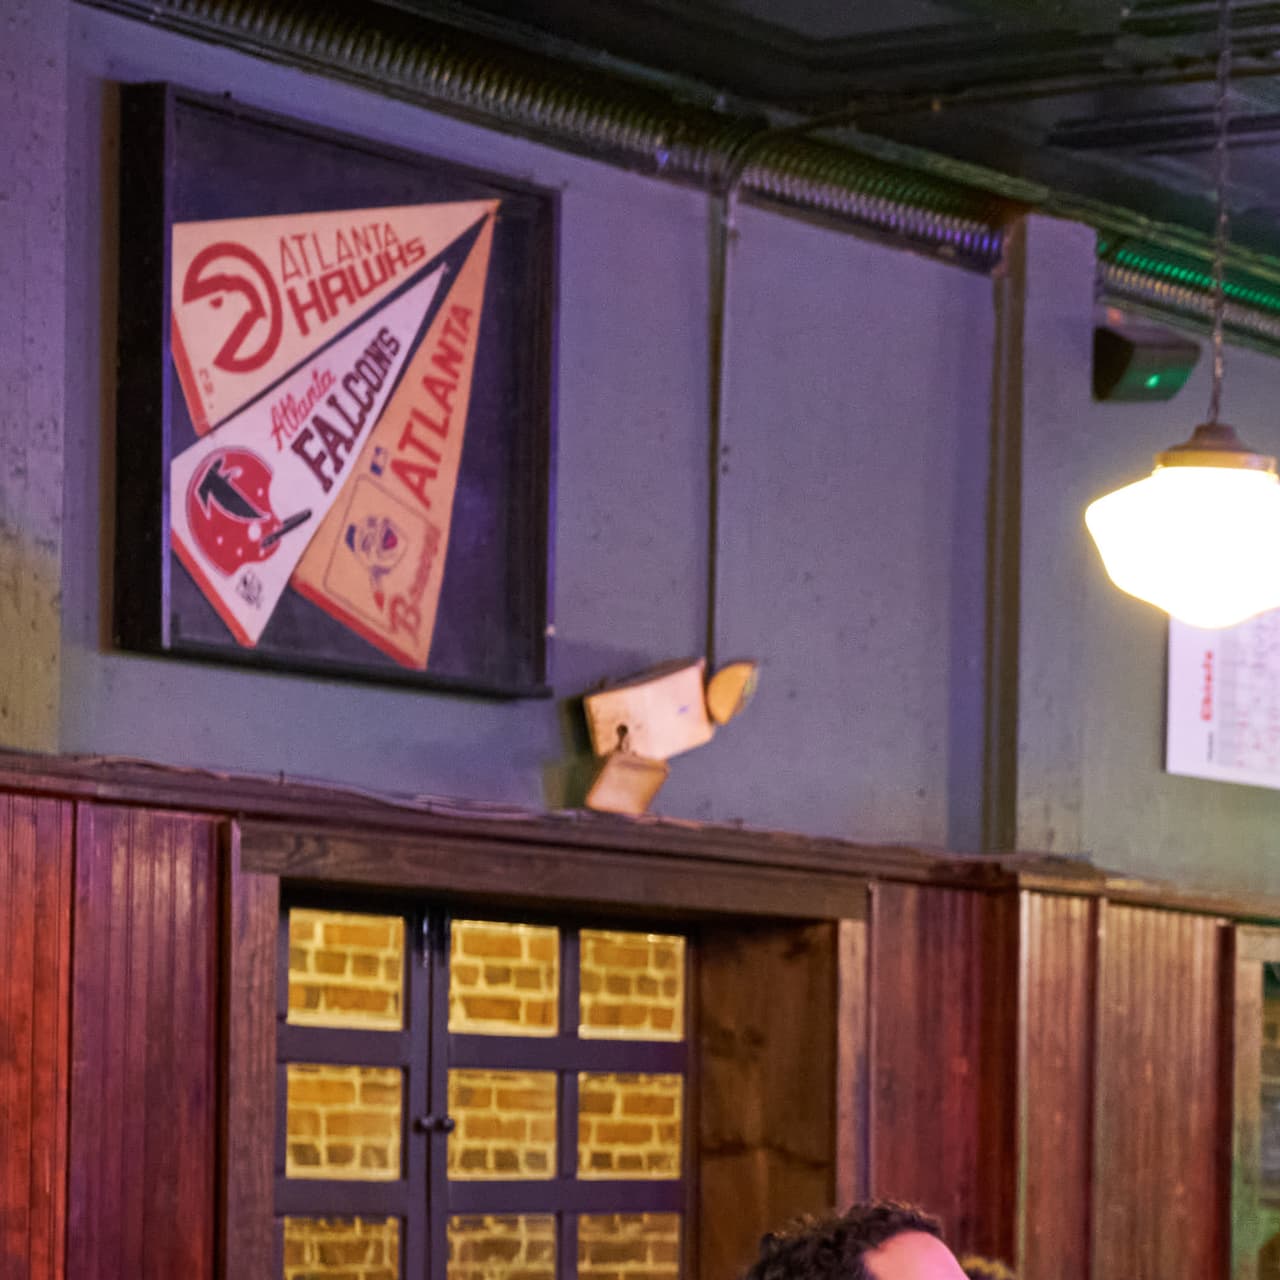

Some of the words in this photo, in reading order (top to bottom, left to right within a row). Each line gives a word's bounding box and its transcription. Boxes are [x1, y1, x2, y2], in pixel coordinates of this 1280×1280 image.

[279, 221, 398, 283] ATLANTA
[286, 236, 426, 336] HAWKS
[270, 368, 336, 451] Atlanta
[291, 326, 401, 494] FALCONS
[390, 305, 473, 510] ATLANTA
